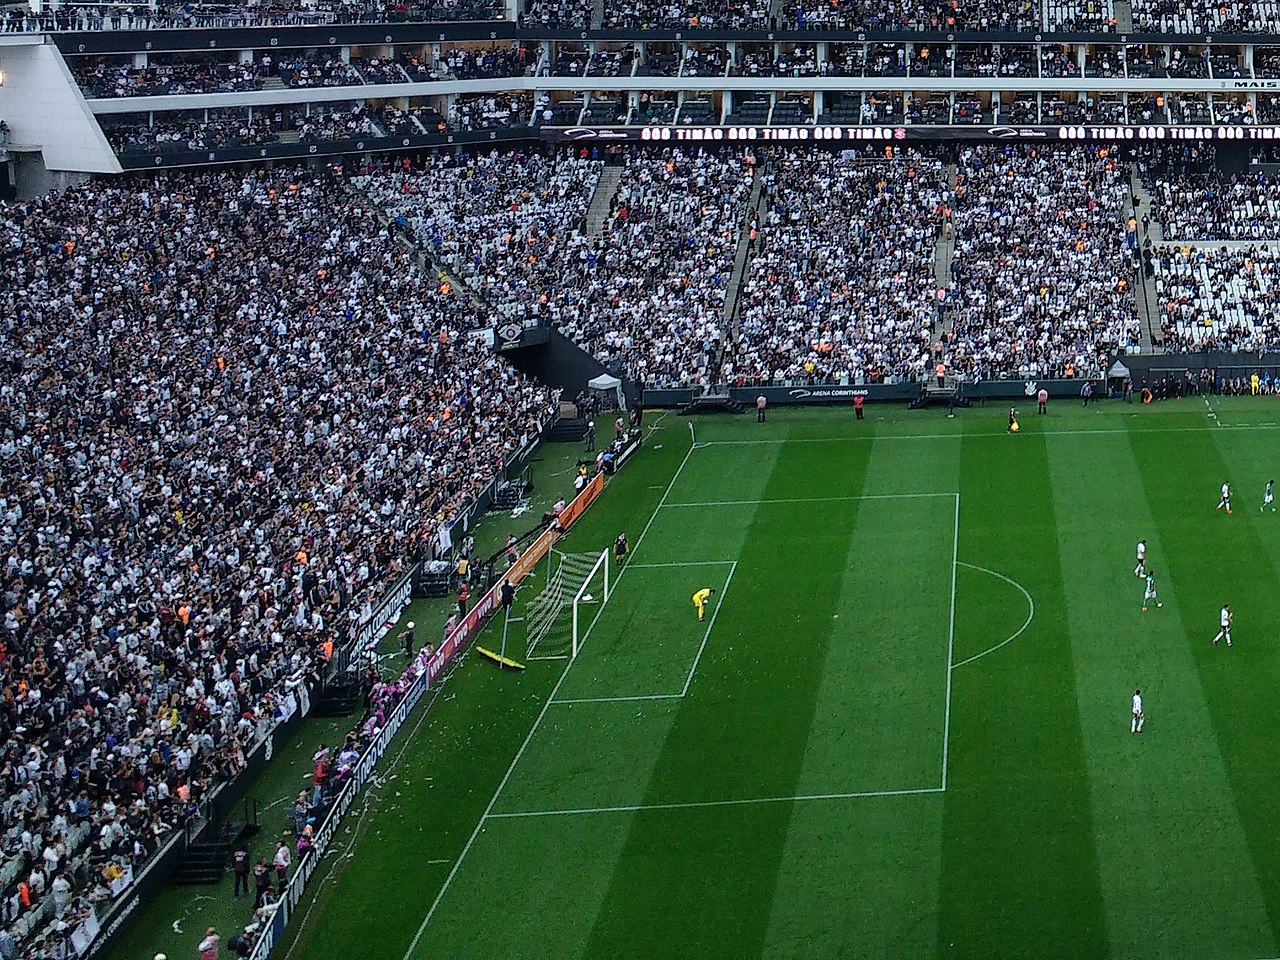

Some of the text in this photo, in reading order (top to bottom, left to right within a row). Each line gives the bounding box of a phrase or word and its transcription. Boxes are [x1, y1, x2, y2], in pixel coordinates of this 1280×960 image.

[676, 127, 723, 140] TIMÃO
[763, 127, 809, 140] TIMÃO
[847, 127, 893, 140] TIMÃO
[1090, 127, 1134, 140] TIMÃO
[1170, 127, 1213, 140] TIMÃO
[372, 578, 413, 632] CORINTHIANS
